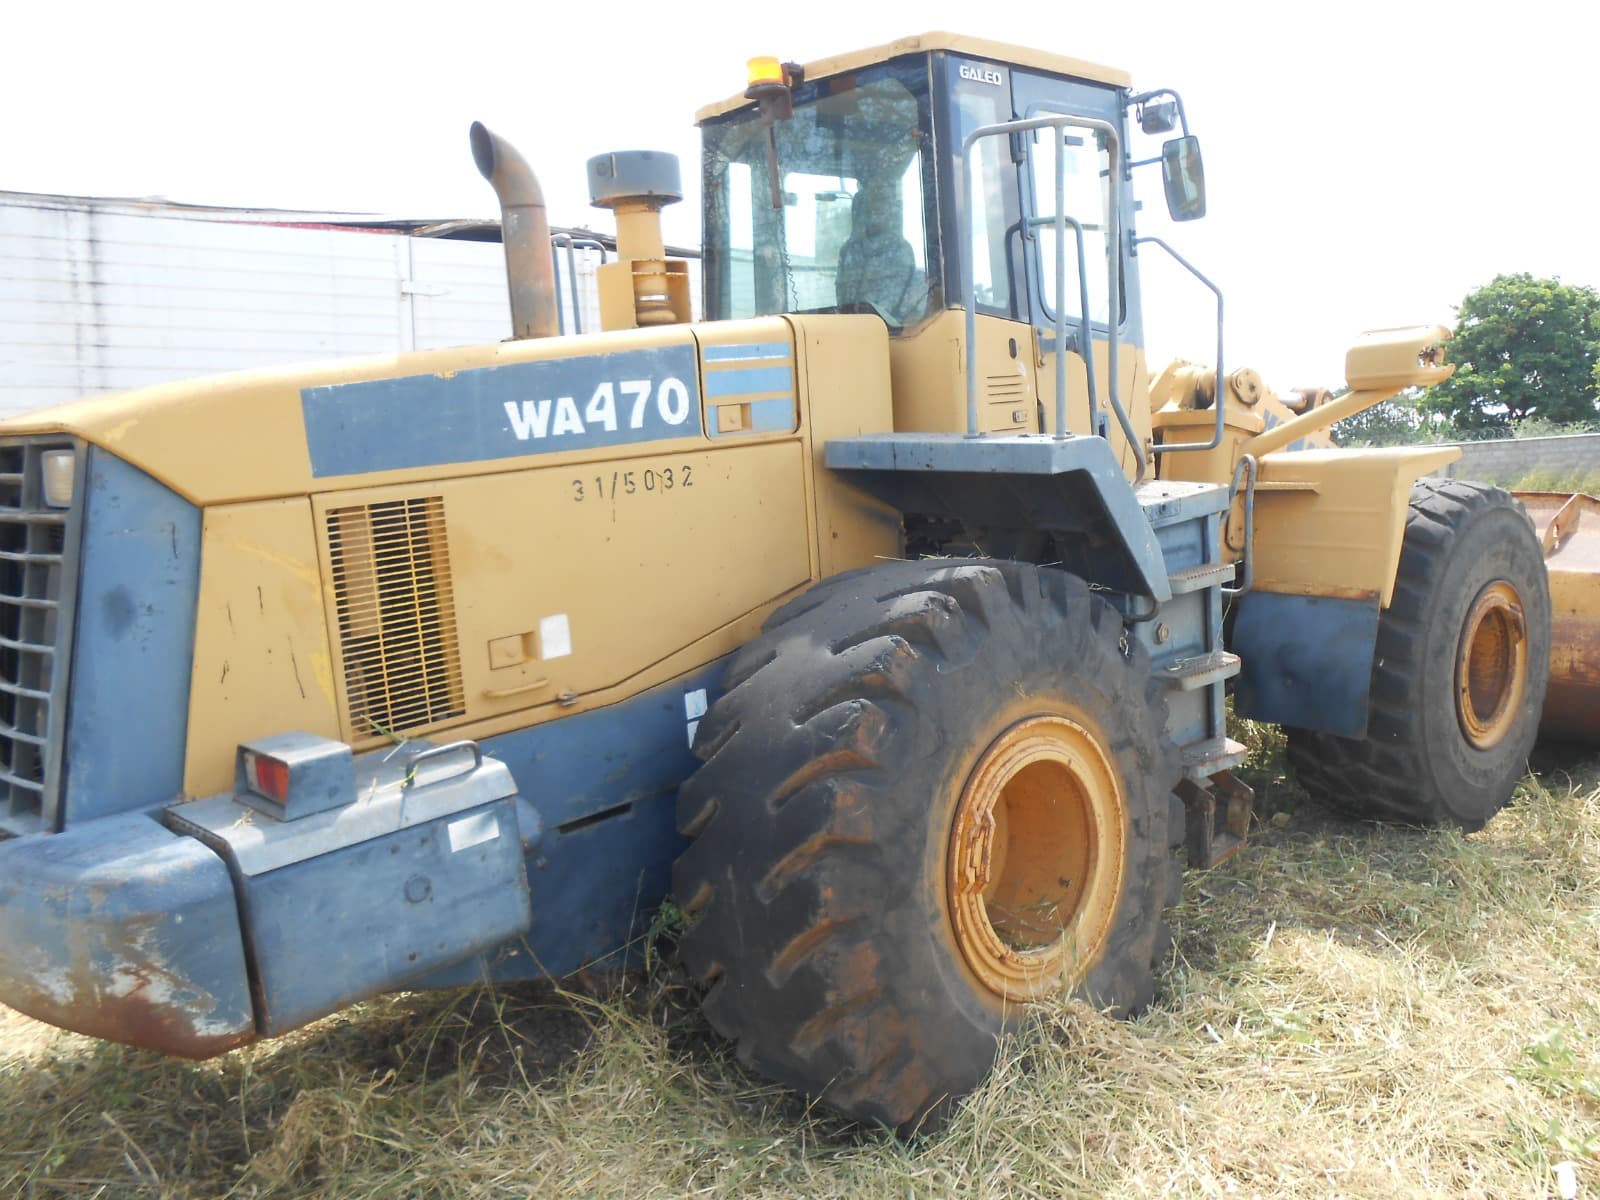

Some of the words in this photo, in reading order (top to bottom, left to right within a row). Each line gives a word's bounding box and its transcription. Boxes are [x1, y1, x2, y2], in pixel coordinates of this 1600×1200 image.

[959, 65, 1002, 86] GALEO
[504, 377, 690, 440] WA470
[572, 465, 693, 502] 31/5032
